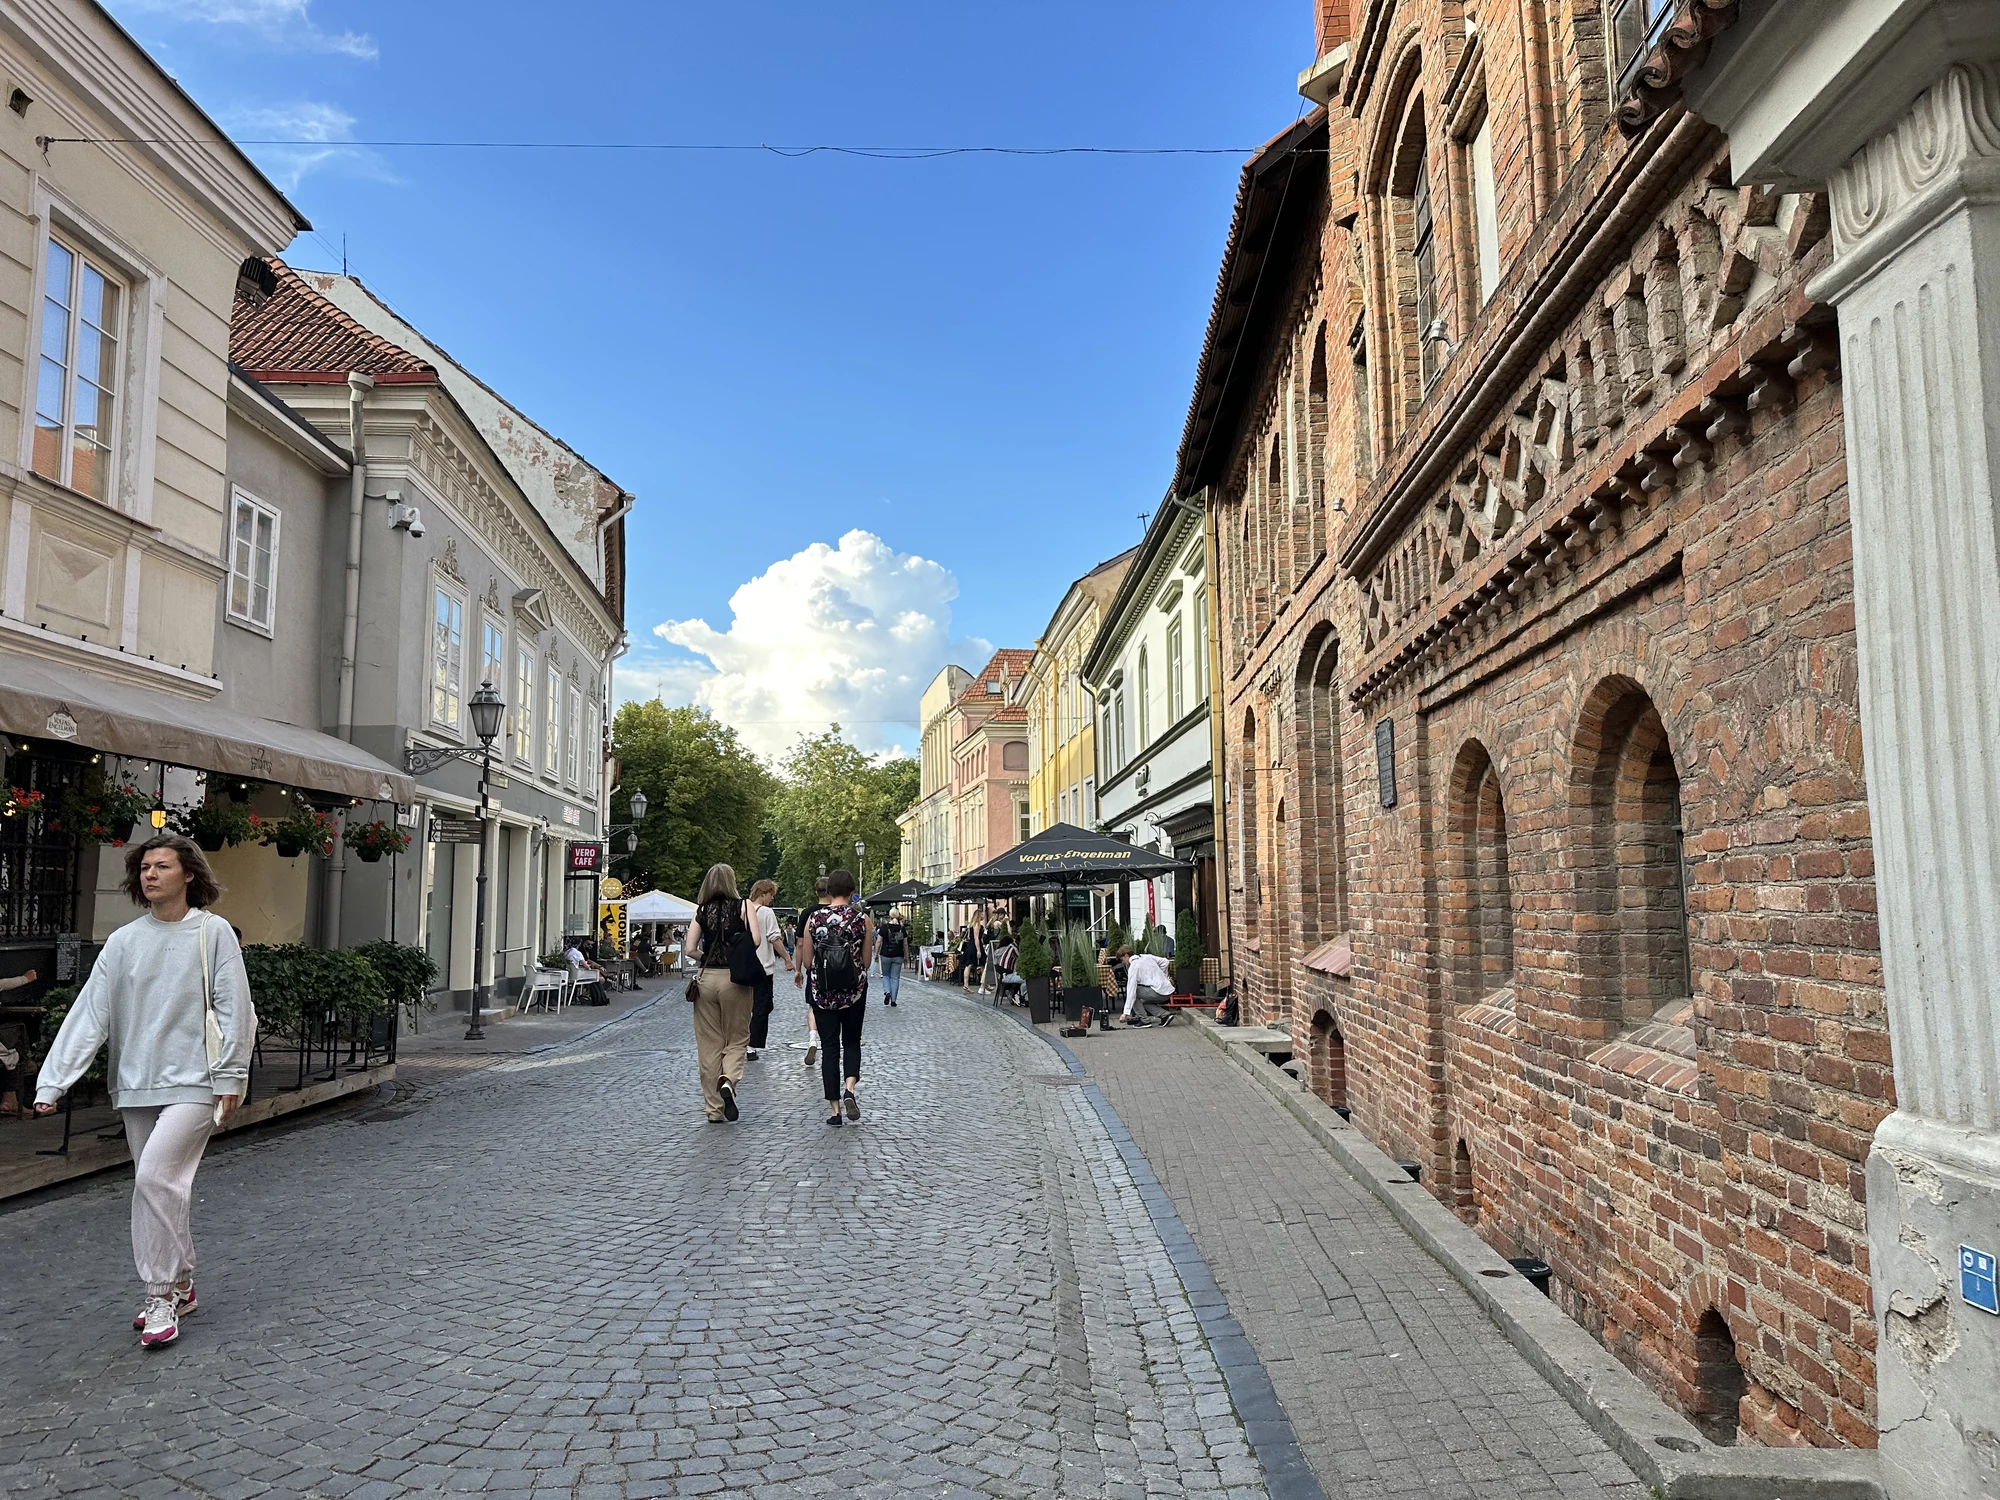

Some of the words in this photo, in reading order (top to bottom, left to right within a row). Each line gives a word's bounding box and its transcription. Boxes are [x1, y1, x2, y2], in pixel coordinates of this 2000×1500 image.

[575, 848, 596, 857] VERO
[574, 857, 593, 866] CAFE
[617, 903, 628, 954] PARODA
